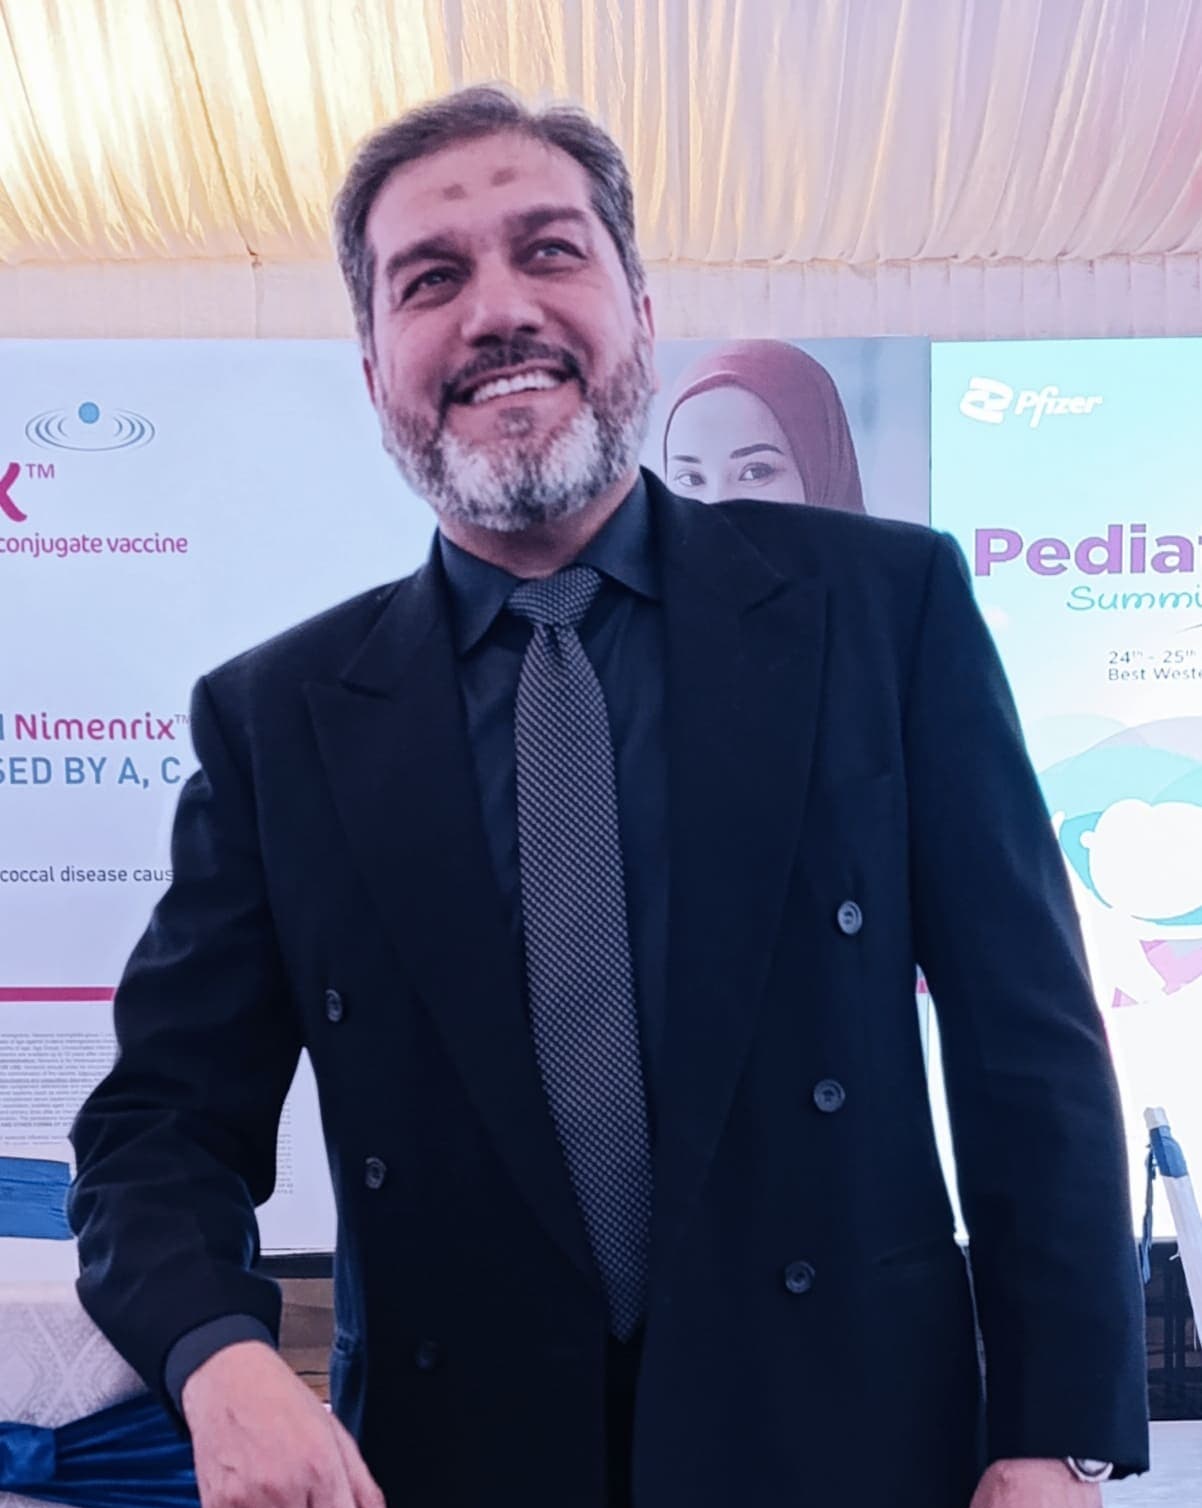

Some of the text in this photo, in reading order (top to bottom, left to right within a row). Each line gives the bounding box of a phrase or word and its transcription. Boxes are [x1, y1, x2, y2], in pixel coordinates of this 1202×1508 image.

[1014, 385, 1103, 428] Pfizer
[106, 532, 188, 553] vaccine
[974, 523, 1202, 577] Pedia
[1108, 667, 1146, 681] Best
[65, 757, 107, 785] BY
[118, 756, 149, 789] A,
[0, 865, 54, 882] coccal
[60, 865, 128, 882] disease
